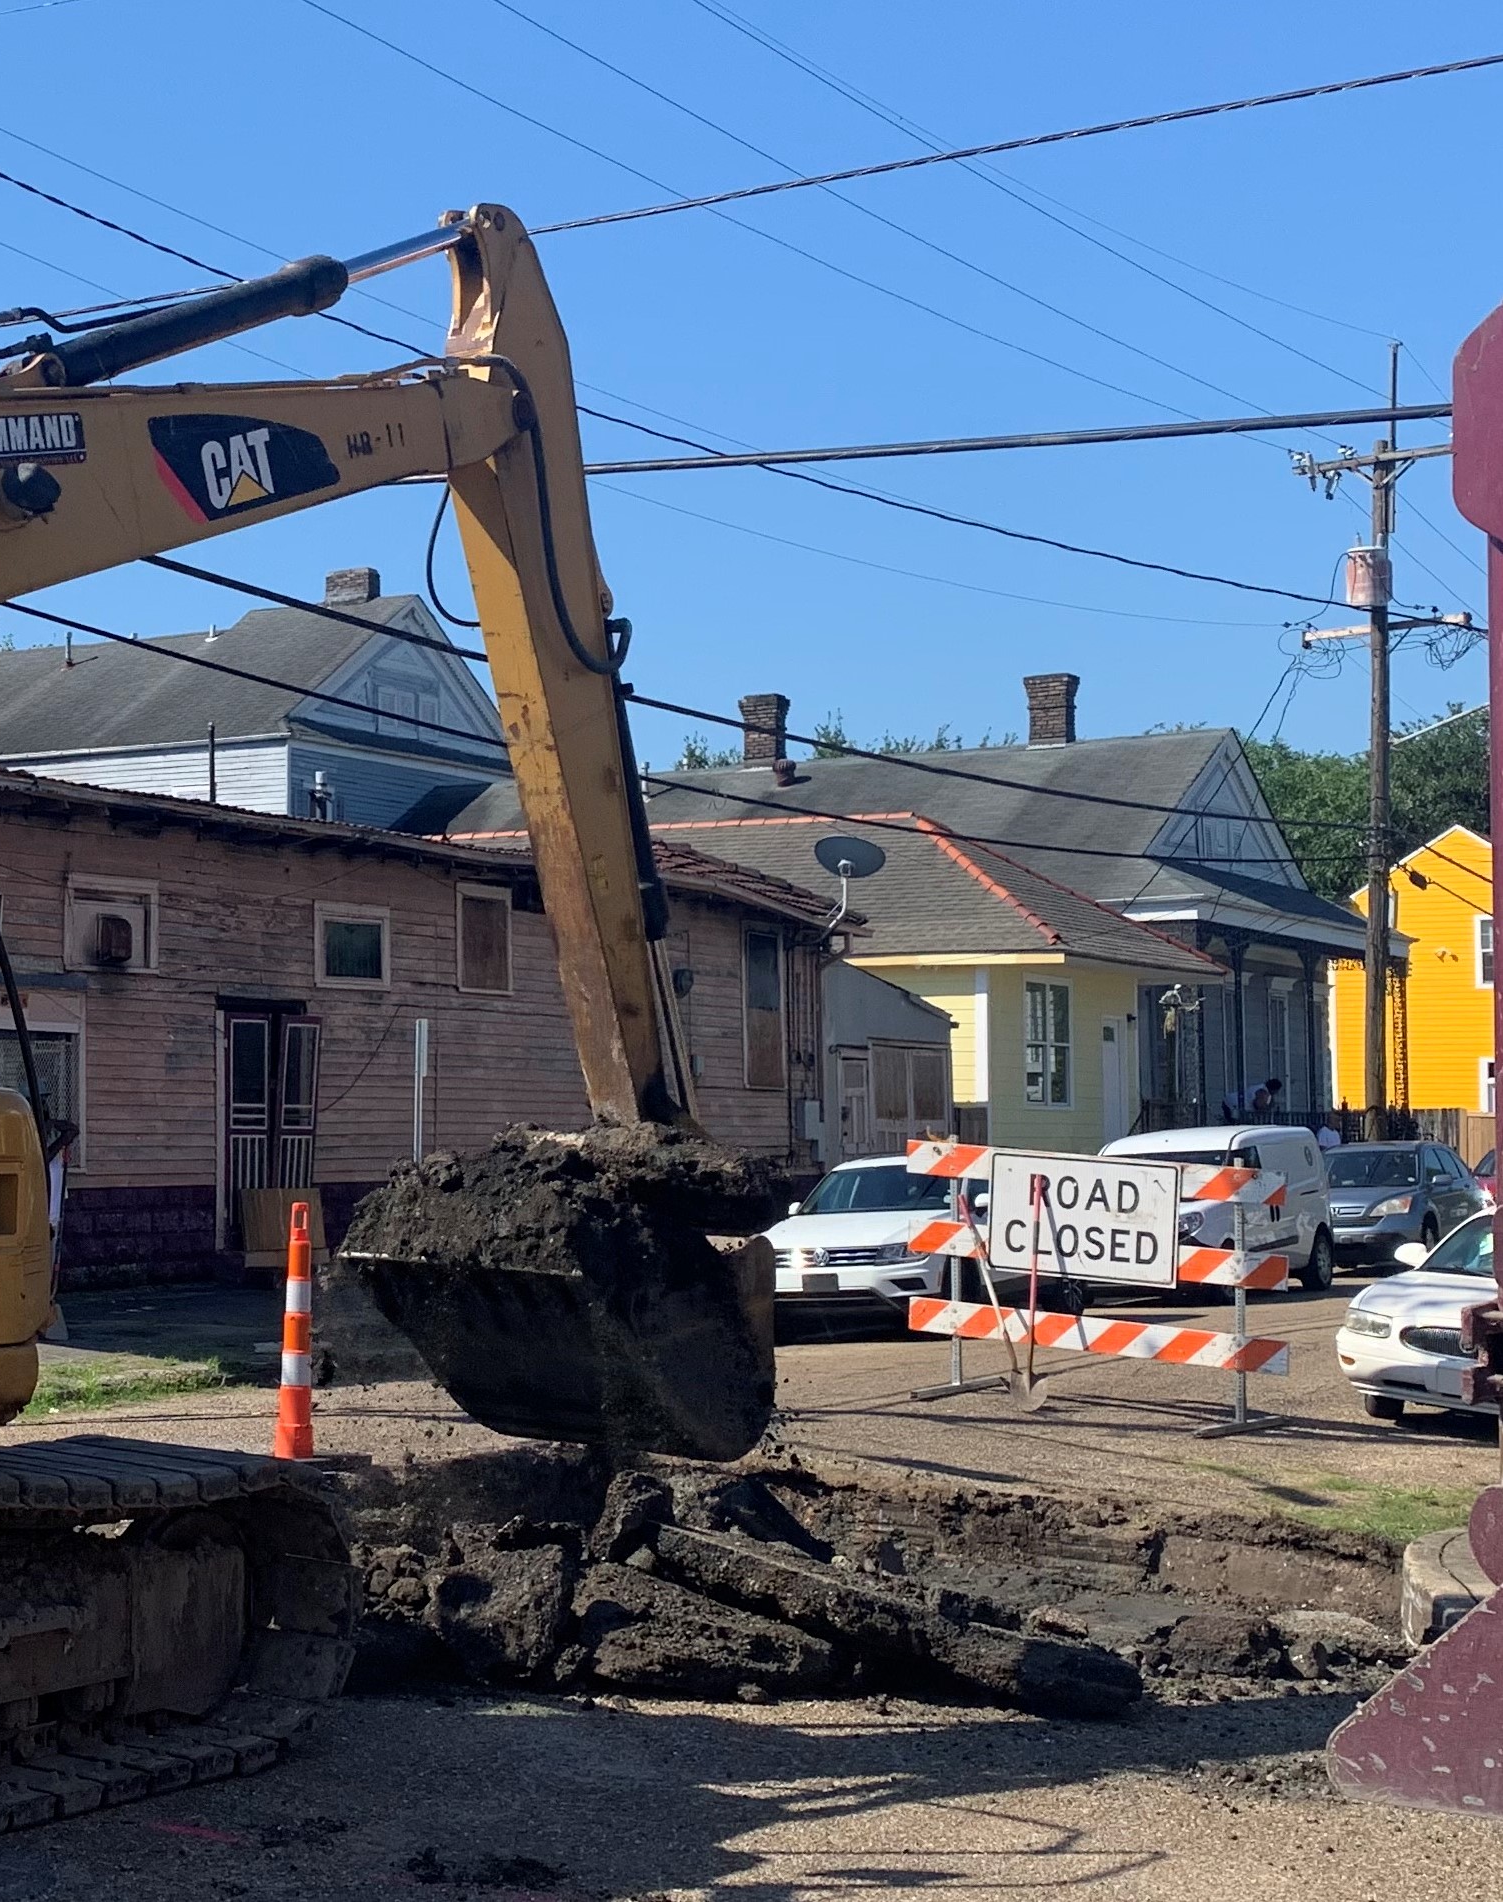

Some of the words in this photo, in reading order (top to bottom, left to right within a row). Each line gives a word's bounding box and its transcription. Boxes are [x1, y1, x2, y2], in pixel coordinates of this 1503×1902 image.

[200, 428, 275, 509] CAT
[1029, 1173, 1139, 1213] ROAD
[1005, 1219, 1158, 1265] CLOSED
